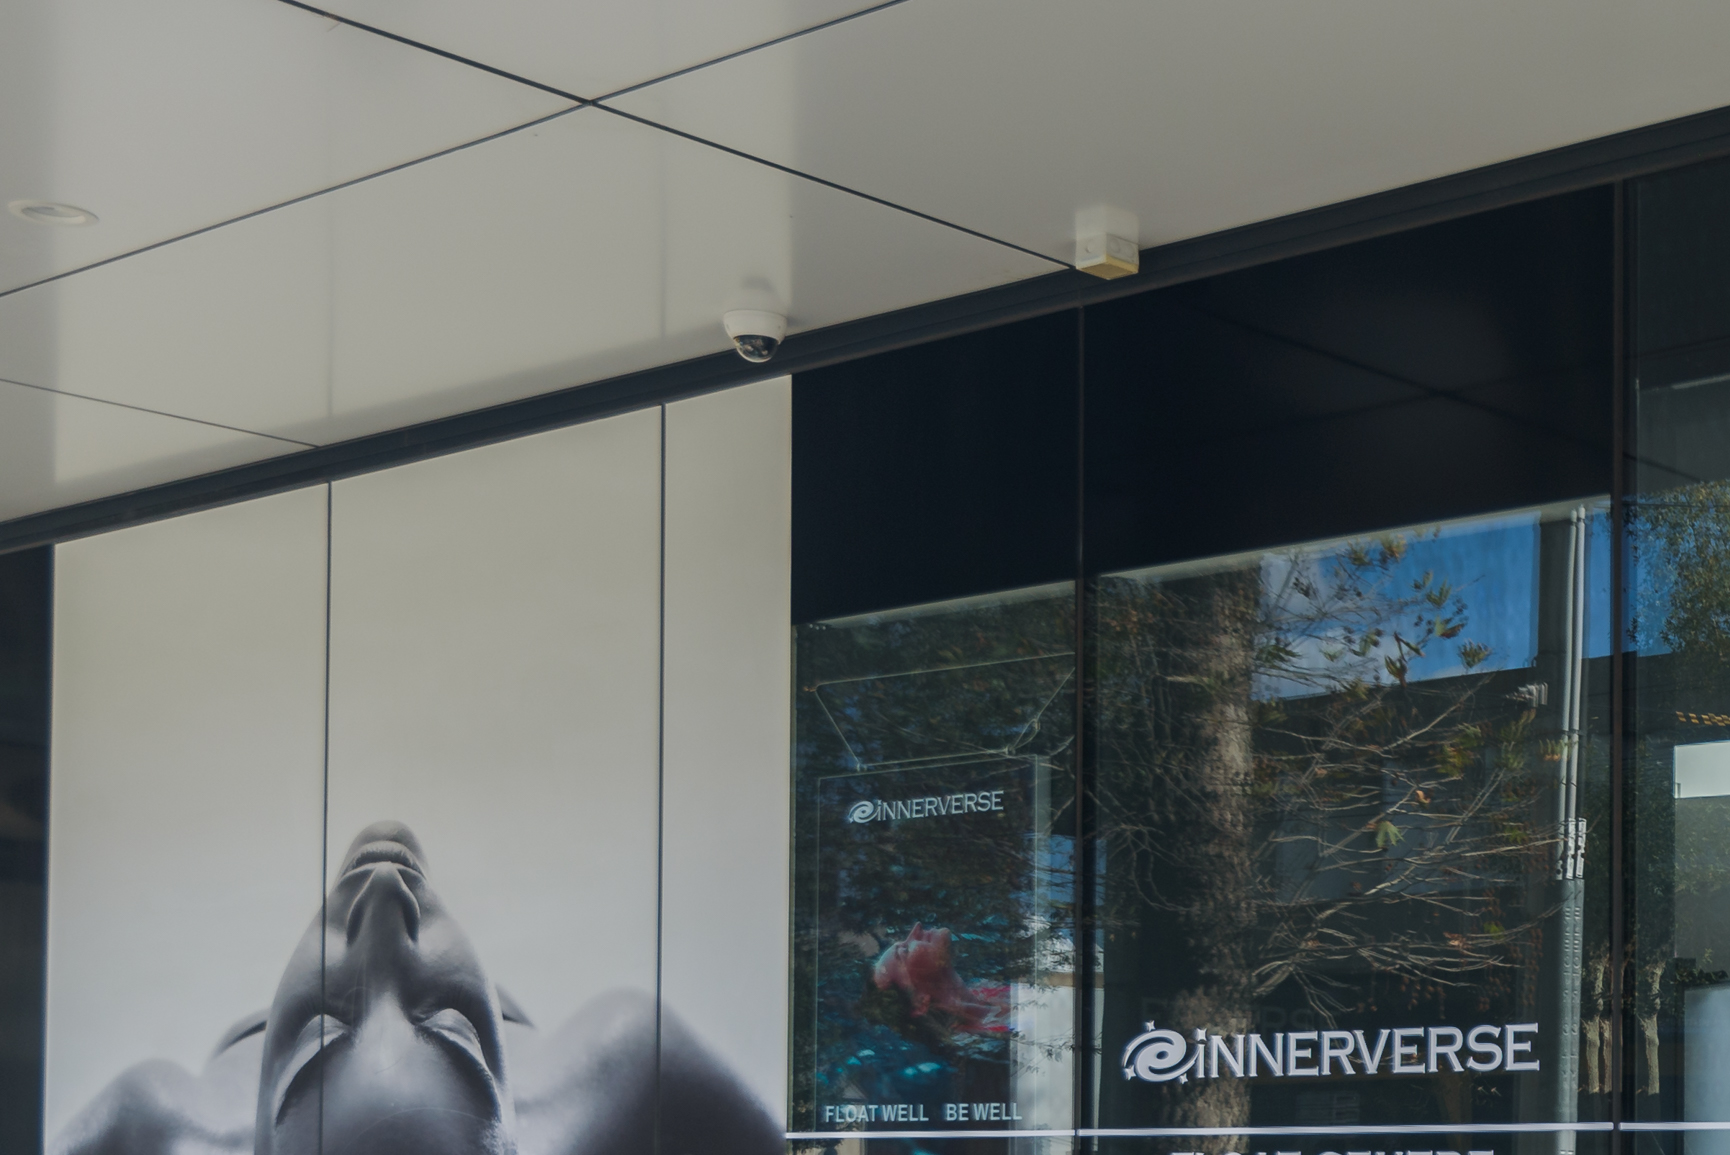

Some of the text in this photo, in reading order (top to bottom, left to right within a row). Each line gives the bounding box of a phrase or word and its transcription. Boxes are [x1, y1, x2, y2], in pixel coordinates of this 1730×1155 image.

[825, 1101, 1023, 1124] FLOAT WELL BE WELL
